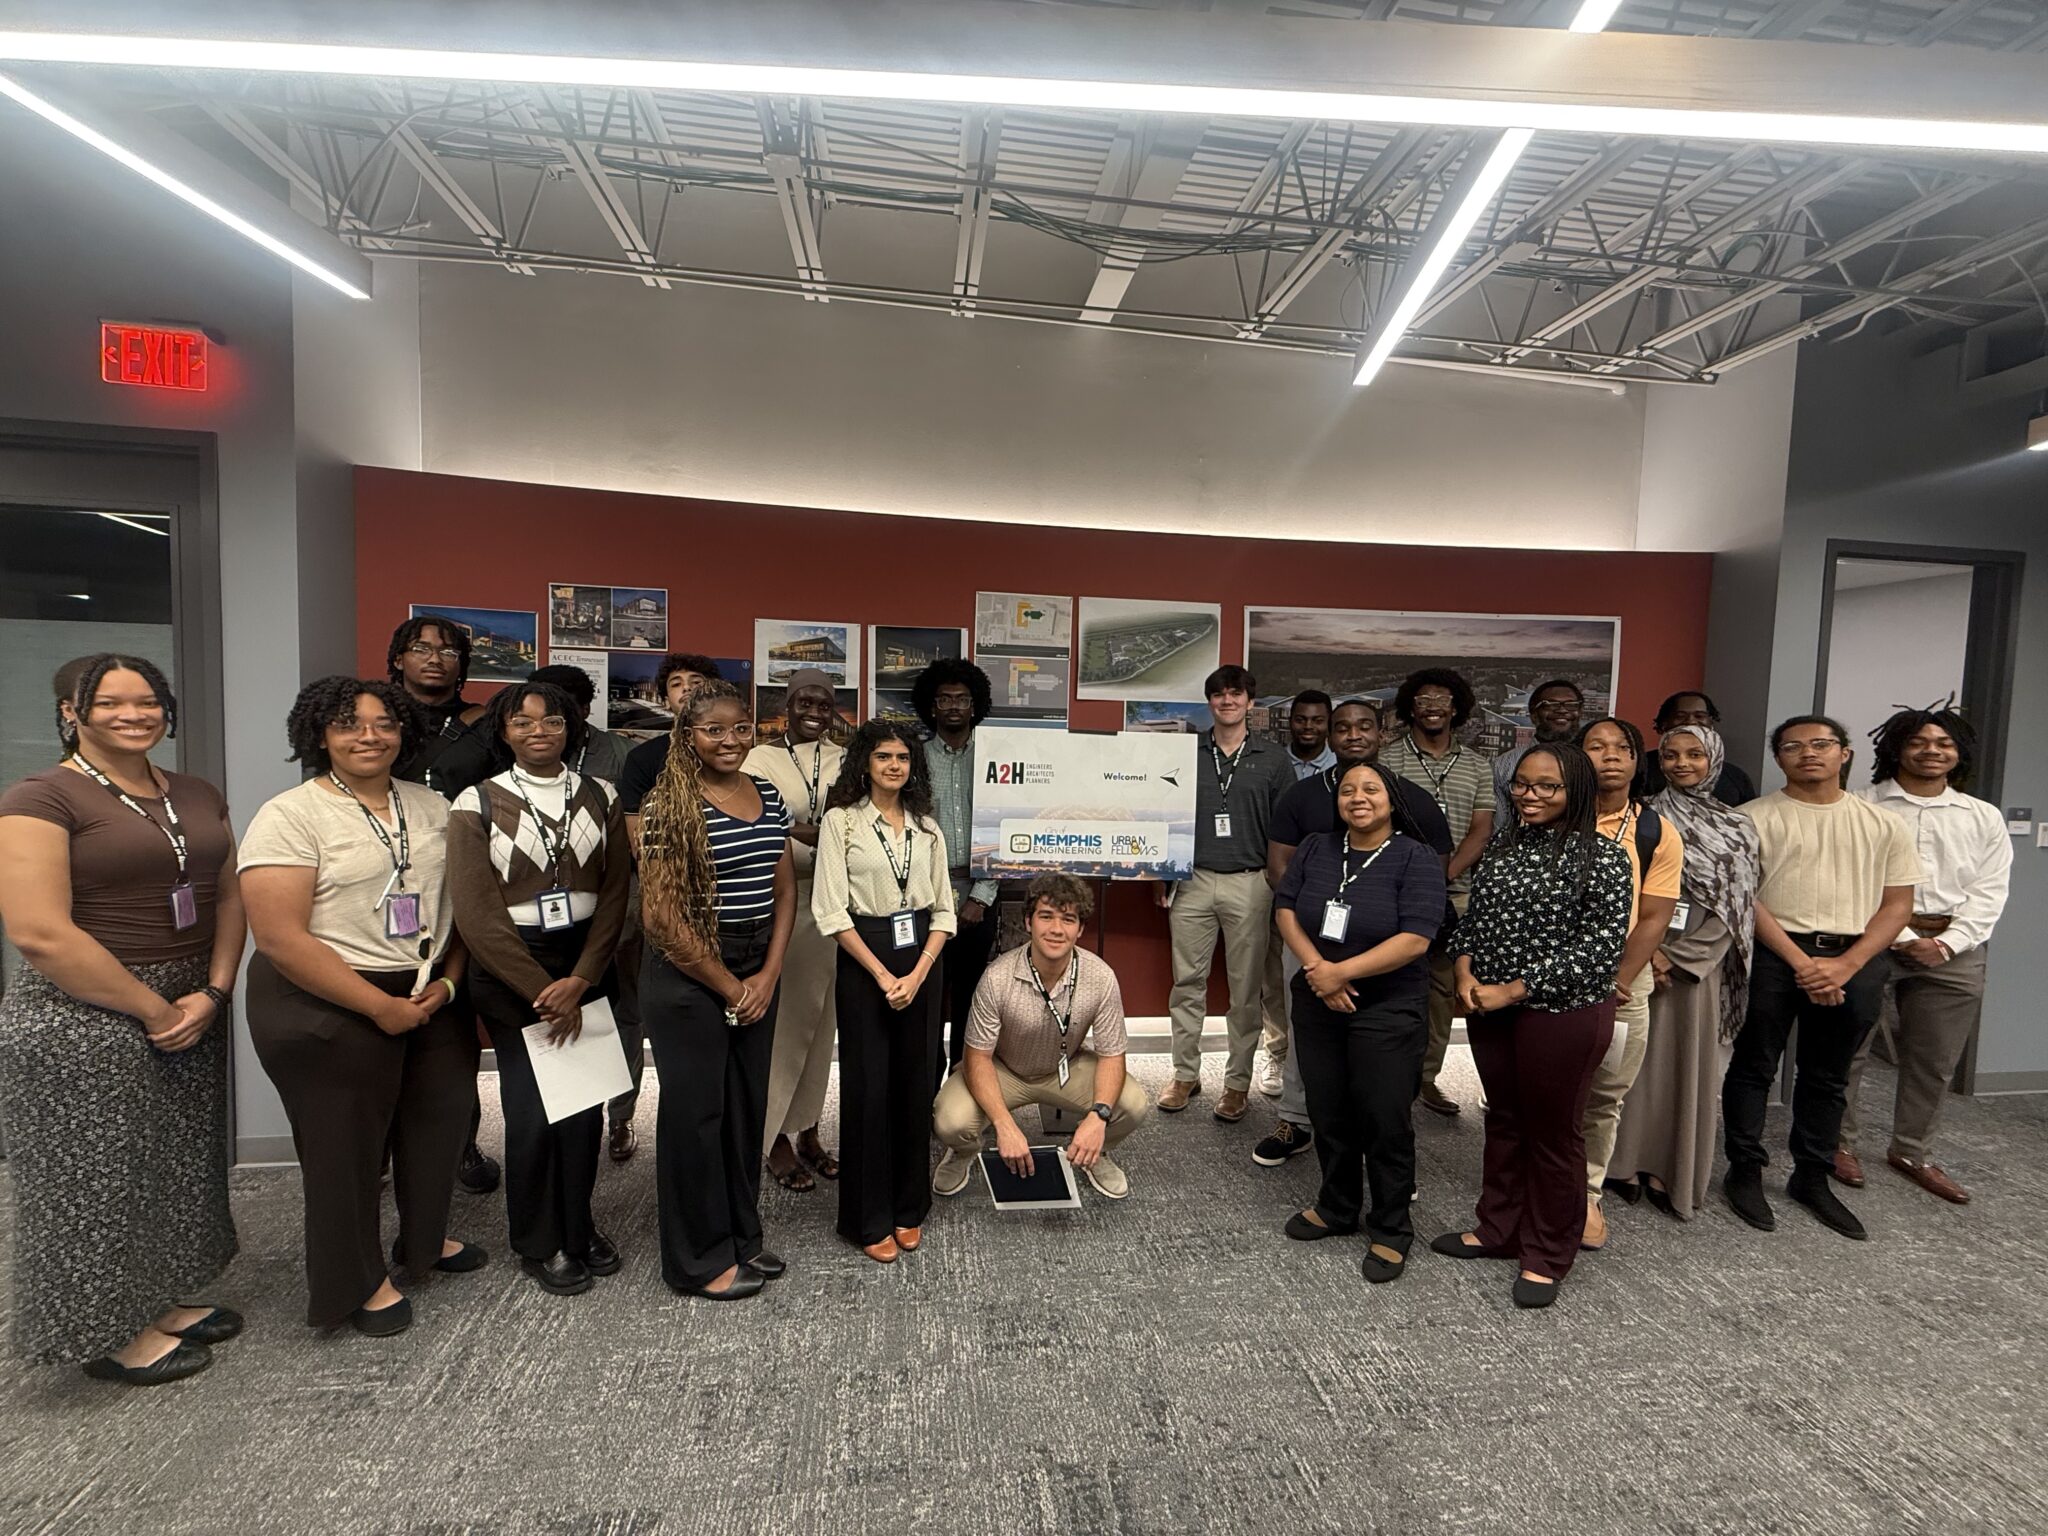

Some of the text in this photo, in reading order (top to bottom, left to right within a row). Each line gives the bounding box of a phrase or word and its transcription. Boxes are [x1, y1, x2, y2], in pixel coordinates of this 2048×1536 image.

[121, 330, 194, 386] EXIT
[986, 762, 1024, 784] A2H
[1104, 772, 1147, 781] Welcome!
[1034, 834, 1102, 846] MEMPHIS
[1112, 836, 1146, 845] URBAN
[1033, 846, 1102, 855] ENGINEERING
[1111, 845, 1158, 855] FELLOWS
